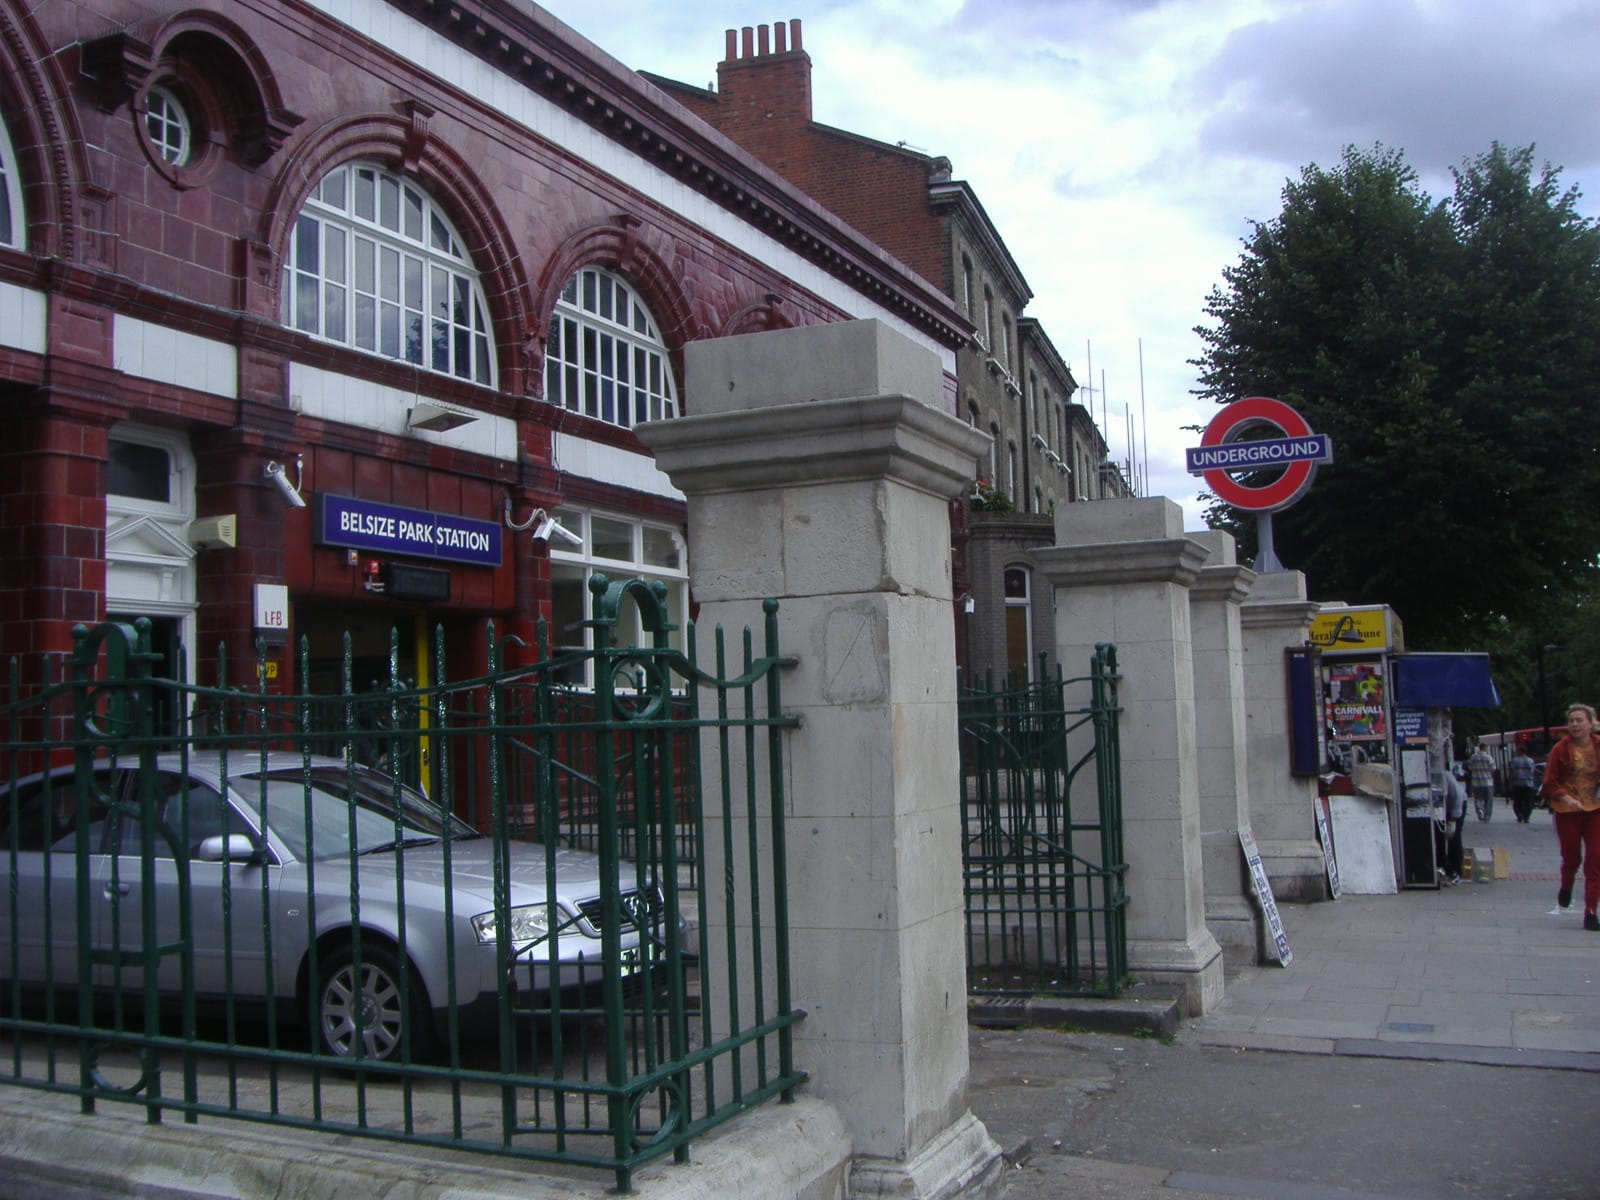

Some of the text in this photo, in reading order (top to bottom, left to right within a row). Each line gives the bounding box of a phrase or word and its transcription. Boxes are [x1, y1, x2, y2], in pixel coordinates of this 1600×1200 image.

[1192, 441, 1320, 466] UNDERGROUND
[340, 511, 489, 552] BELSIZE PARK STATION
[264, 610, 283, 626] LFB
